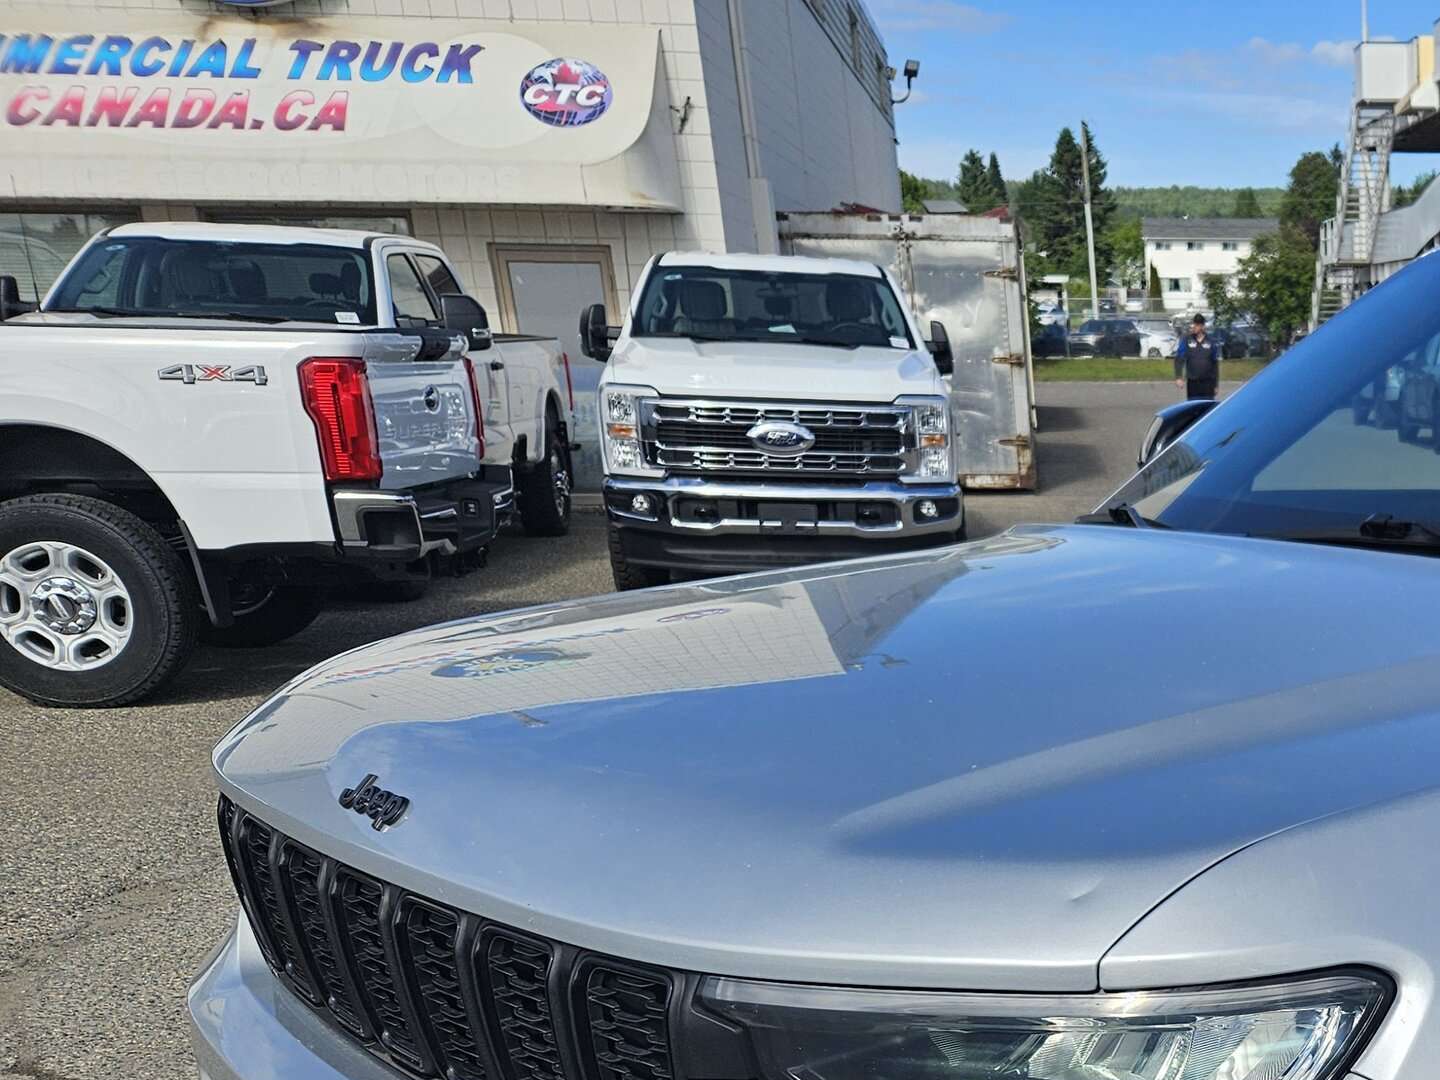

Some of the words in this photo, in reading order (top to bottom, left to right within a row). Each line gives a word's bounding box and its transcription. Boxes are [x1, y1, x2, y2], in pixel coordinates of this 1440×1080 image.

[0, 33, 261, 79] MERCIAL
[286, 40, 485, 84] TRUCK
[5, 85, 349, 132] CANADA.CA
[523, 83, 607, 108] CTC
[339, 773, 410, 832] Jeep
